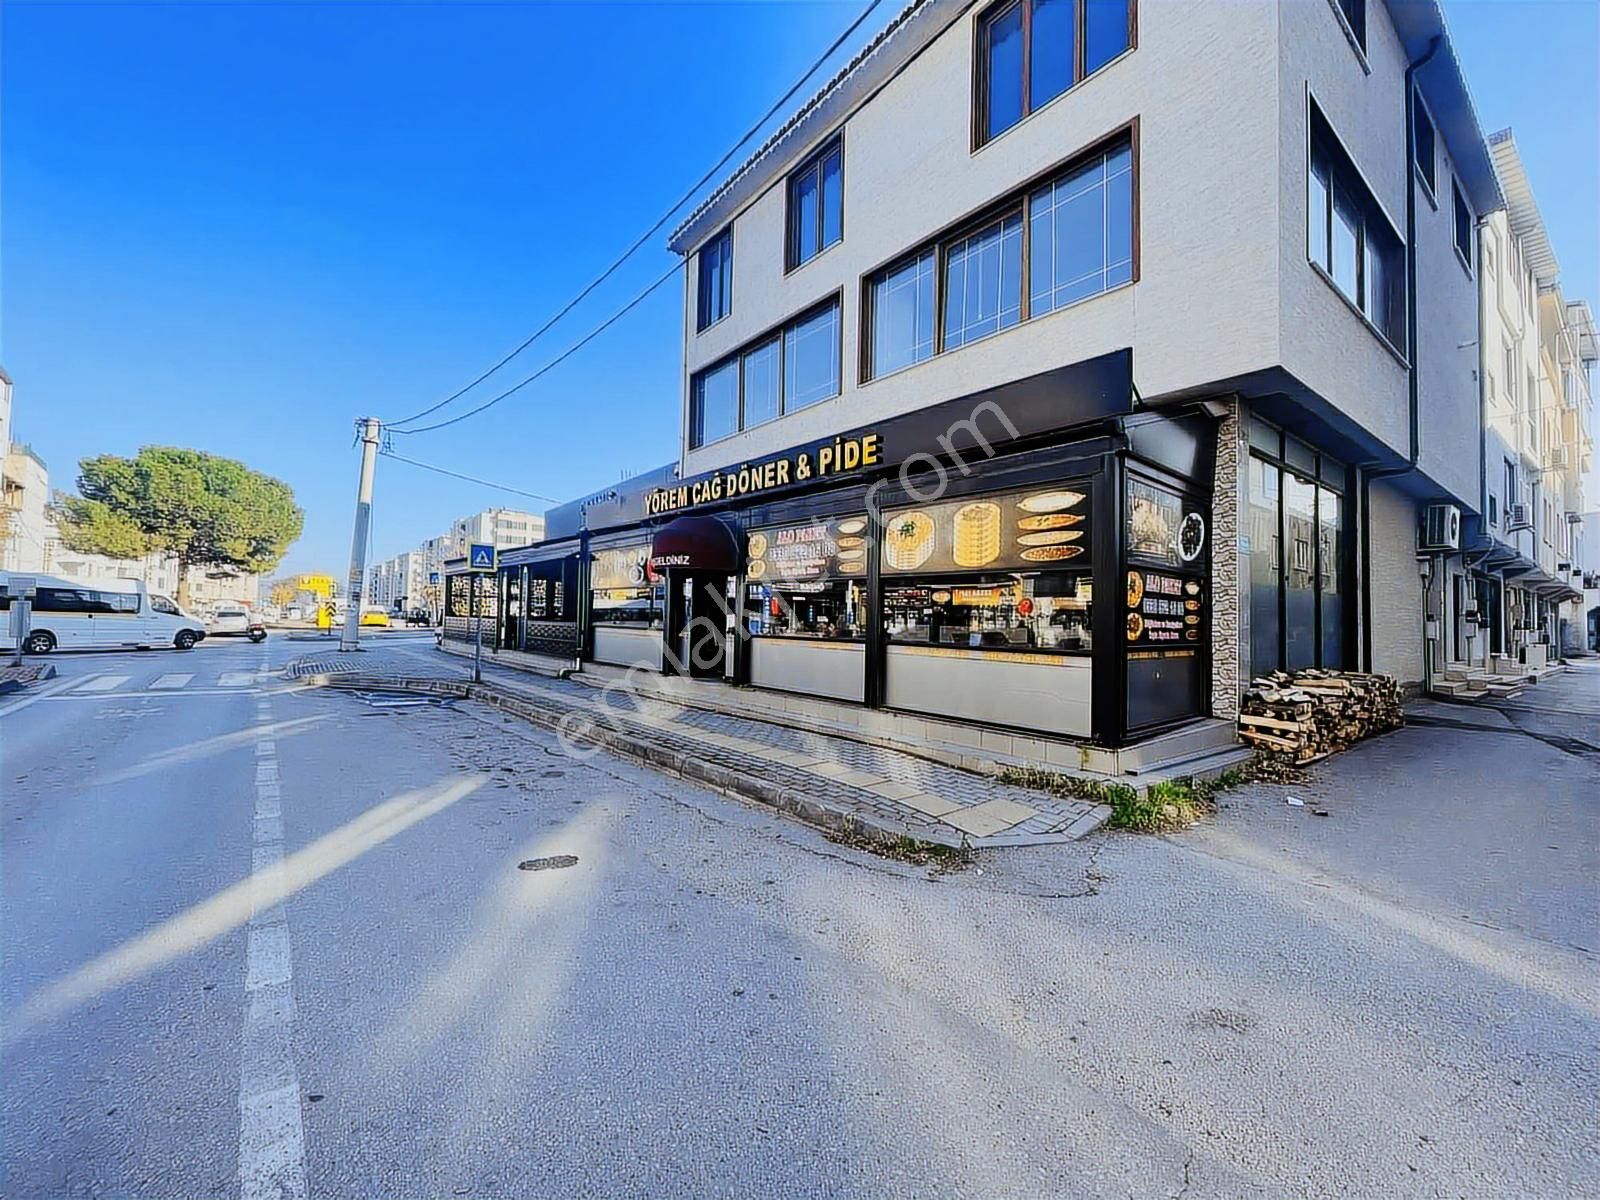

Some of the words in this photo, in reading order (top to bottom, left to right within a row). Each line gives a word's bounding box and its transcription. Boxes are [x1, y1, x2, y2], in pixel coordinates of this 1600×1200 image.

[644, 488, 688, 515] YÖREM
[726, 459, 789, 498] DÖNER
[796, 453, 811, 480] &
[820, 434, 878, 476] PİDE
